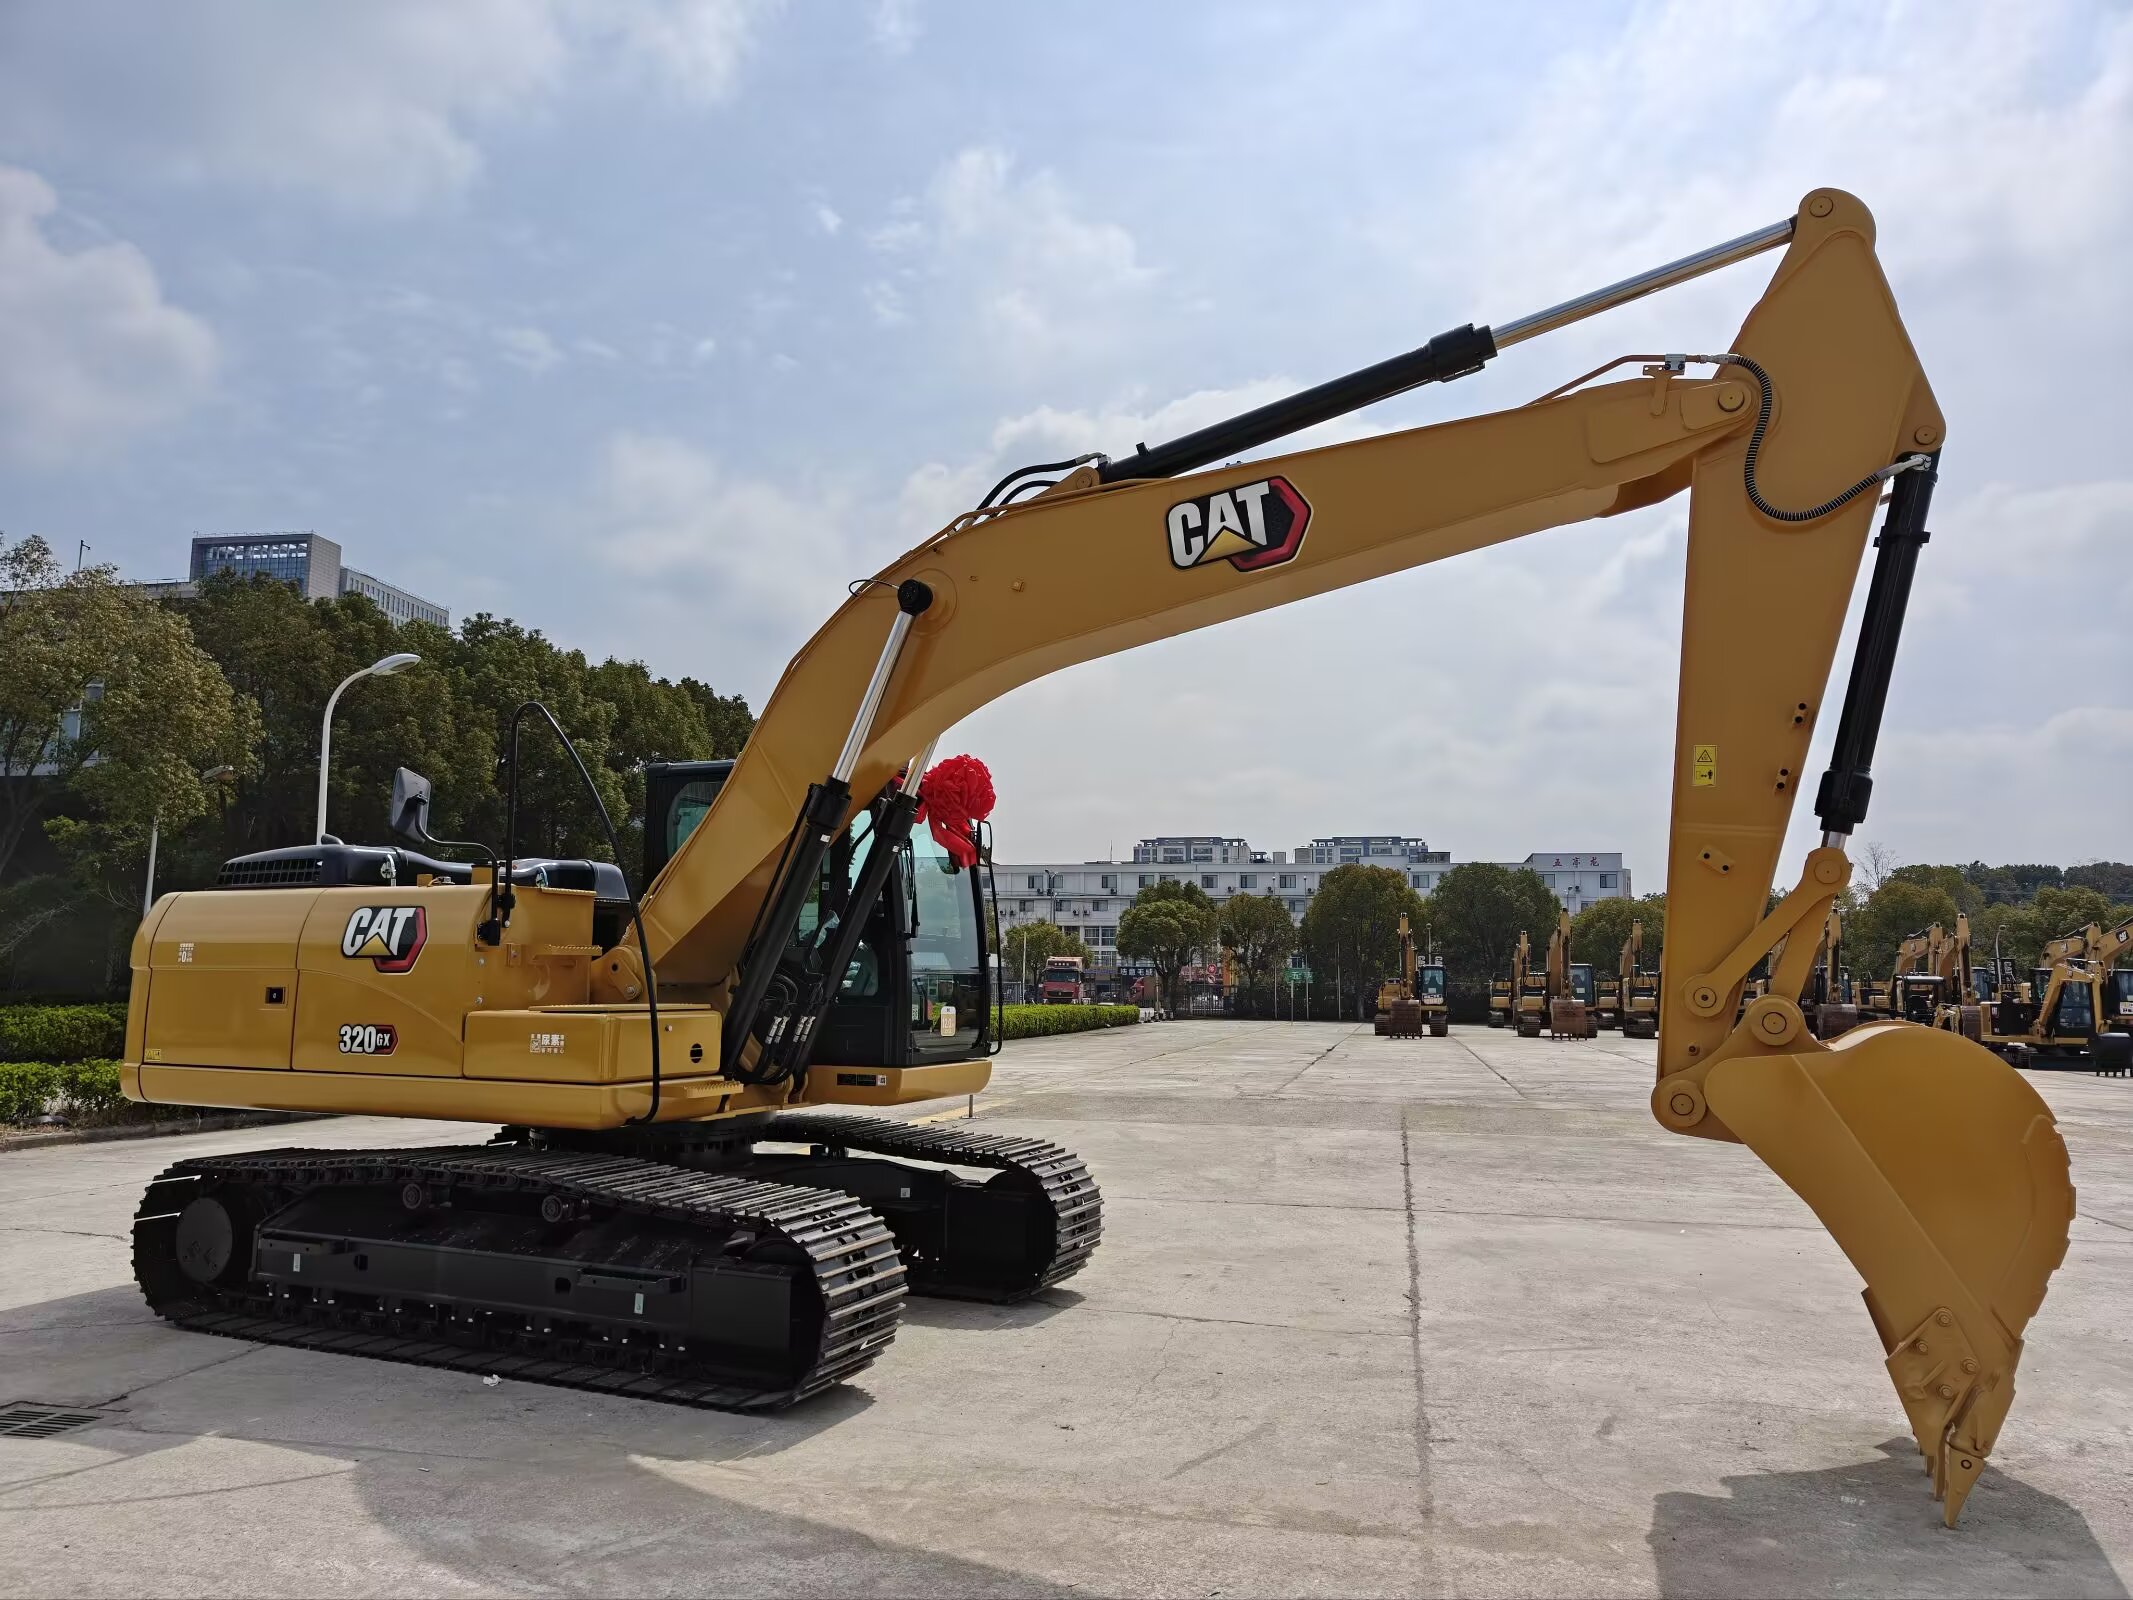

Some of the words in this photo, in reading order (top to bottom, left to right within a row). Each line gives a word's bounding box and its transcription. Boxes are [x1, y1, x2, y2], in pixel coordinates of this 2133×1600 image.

[1168, 481, 1269, 567] CAT
[342, 907, 416, 956] CAT
[339, 1025, 377, 1053] 320
